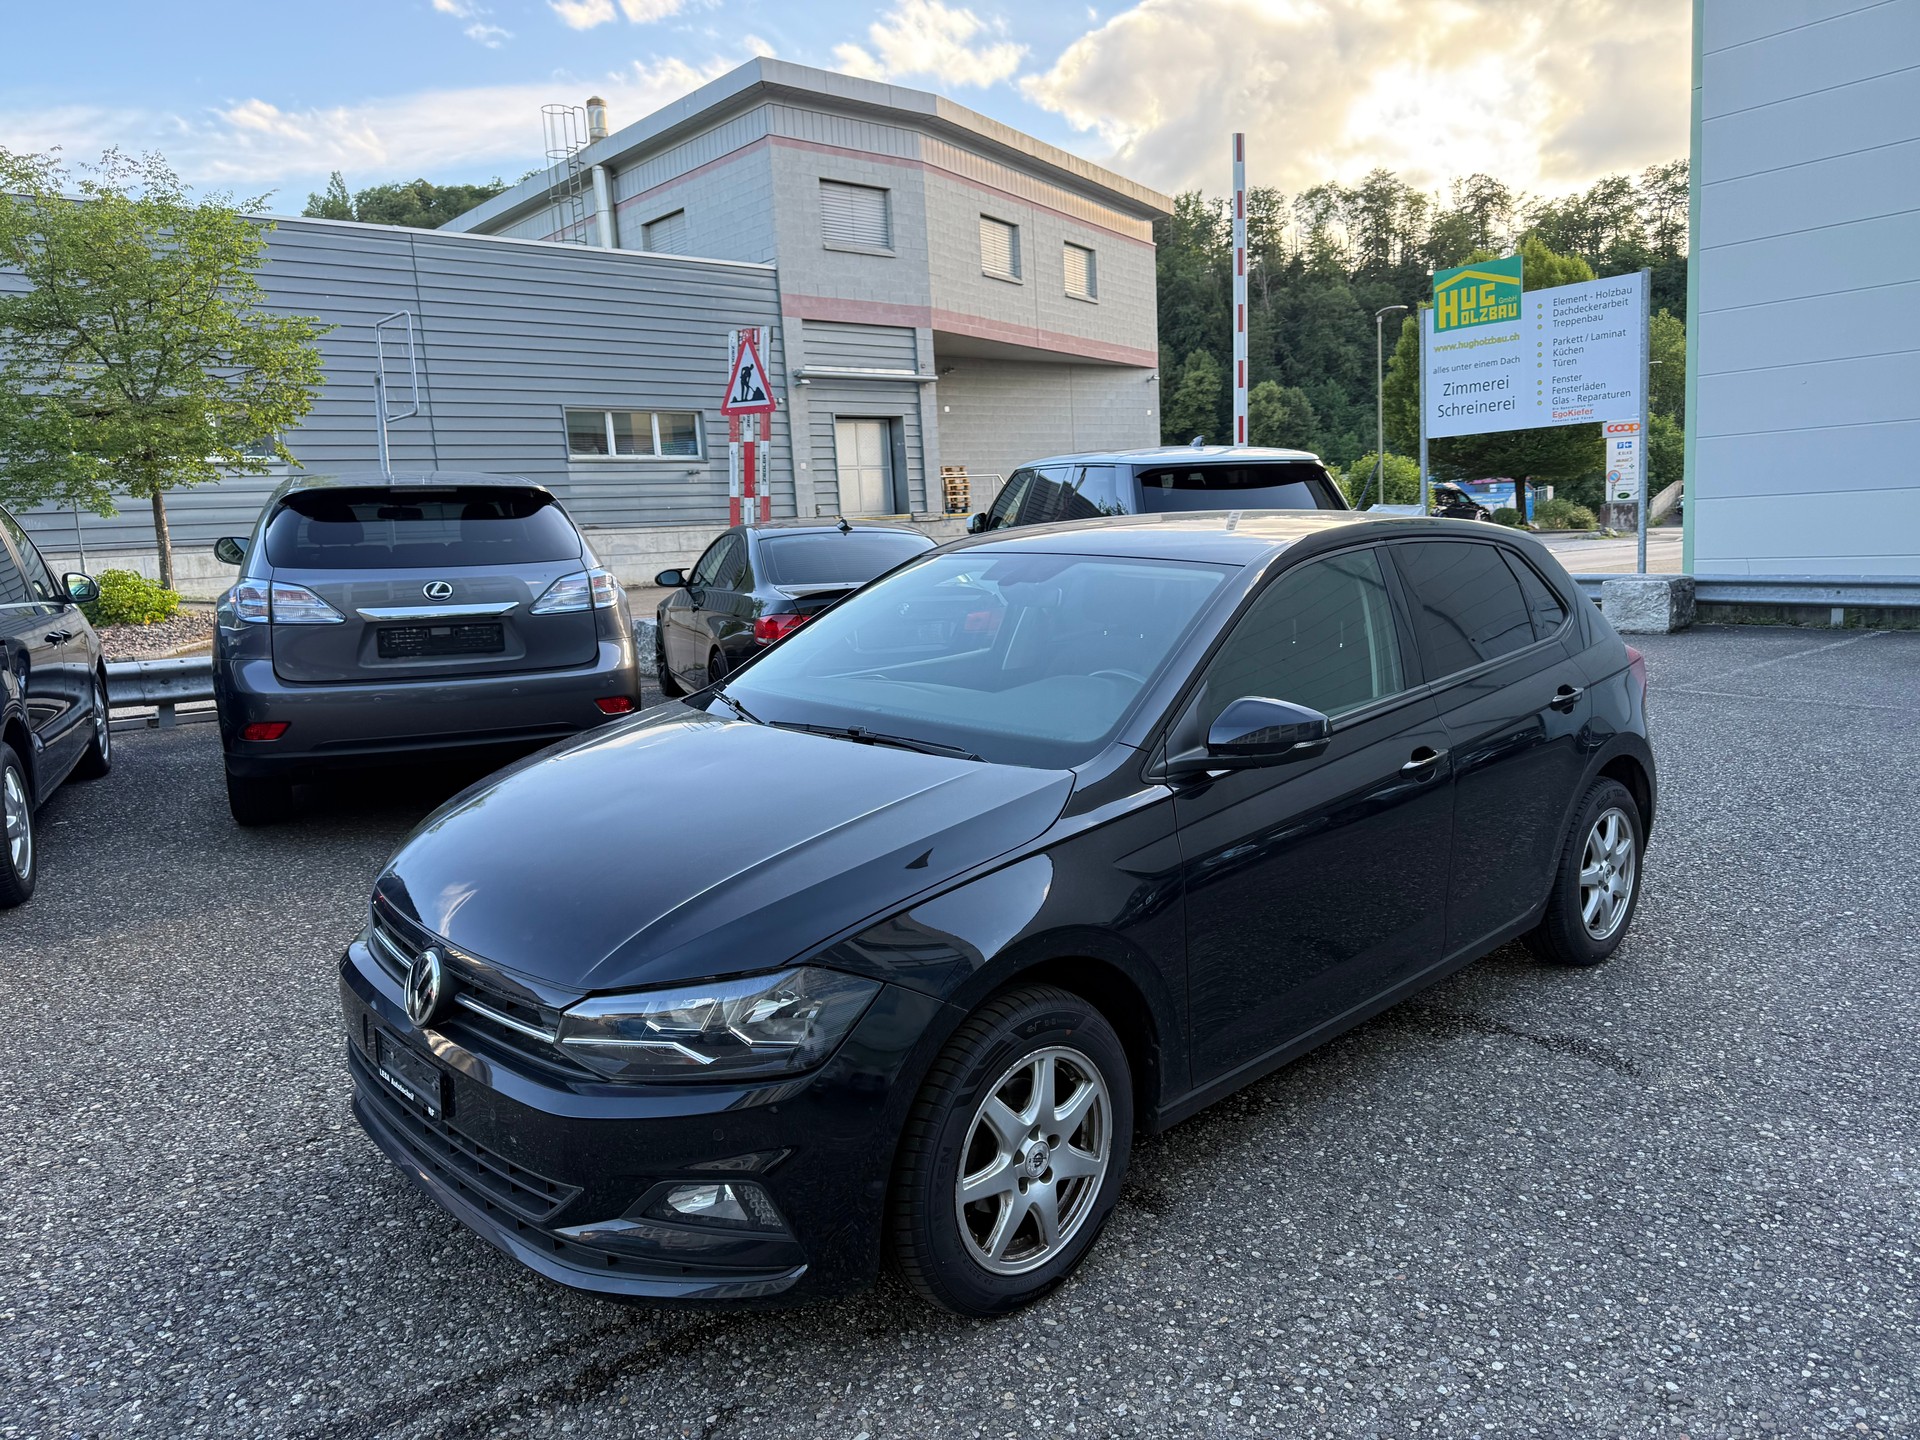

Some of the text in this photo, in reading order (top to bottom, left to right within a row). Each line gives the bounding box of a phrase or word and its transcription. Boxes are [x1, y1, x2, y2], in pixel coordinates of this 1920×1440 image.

[1553, 294, 1588, 307] Element
[1595, 287, 1633, 299] Holzbau
[1553, 298, 1629, 317] Dachdeckerarbeit
[1553, 314, 1604, 328] Treppenbau
[1433, 332, 1520, 352] www.hugholzbau.ch
[1553, 335, 1583, 346] Parkett
[1590, 329, 1626, 341] Laminat
[1553, 346, 1584, 357] Küchen
[1433, 355, 1521, 375] alles unter einem Dach
[1553, 358, 1577, 367] Türen
[1443, 374, 1509, 397] Zimmerei
[1552, 374, 1582, 384] Fenster
[1552, 382, 1606, 395] Fensterläden
[1552, 396, 1570, 405] Glas
[1577, 390, 1631, 403] Reparaturen
[1437, 395, 1515, 418] Schreinerei
[1552, 408, 1594, 419] EgoKiefer
